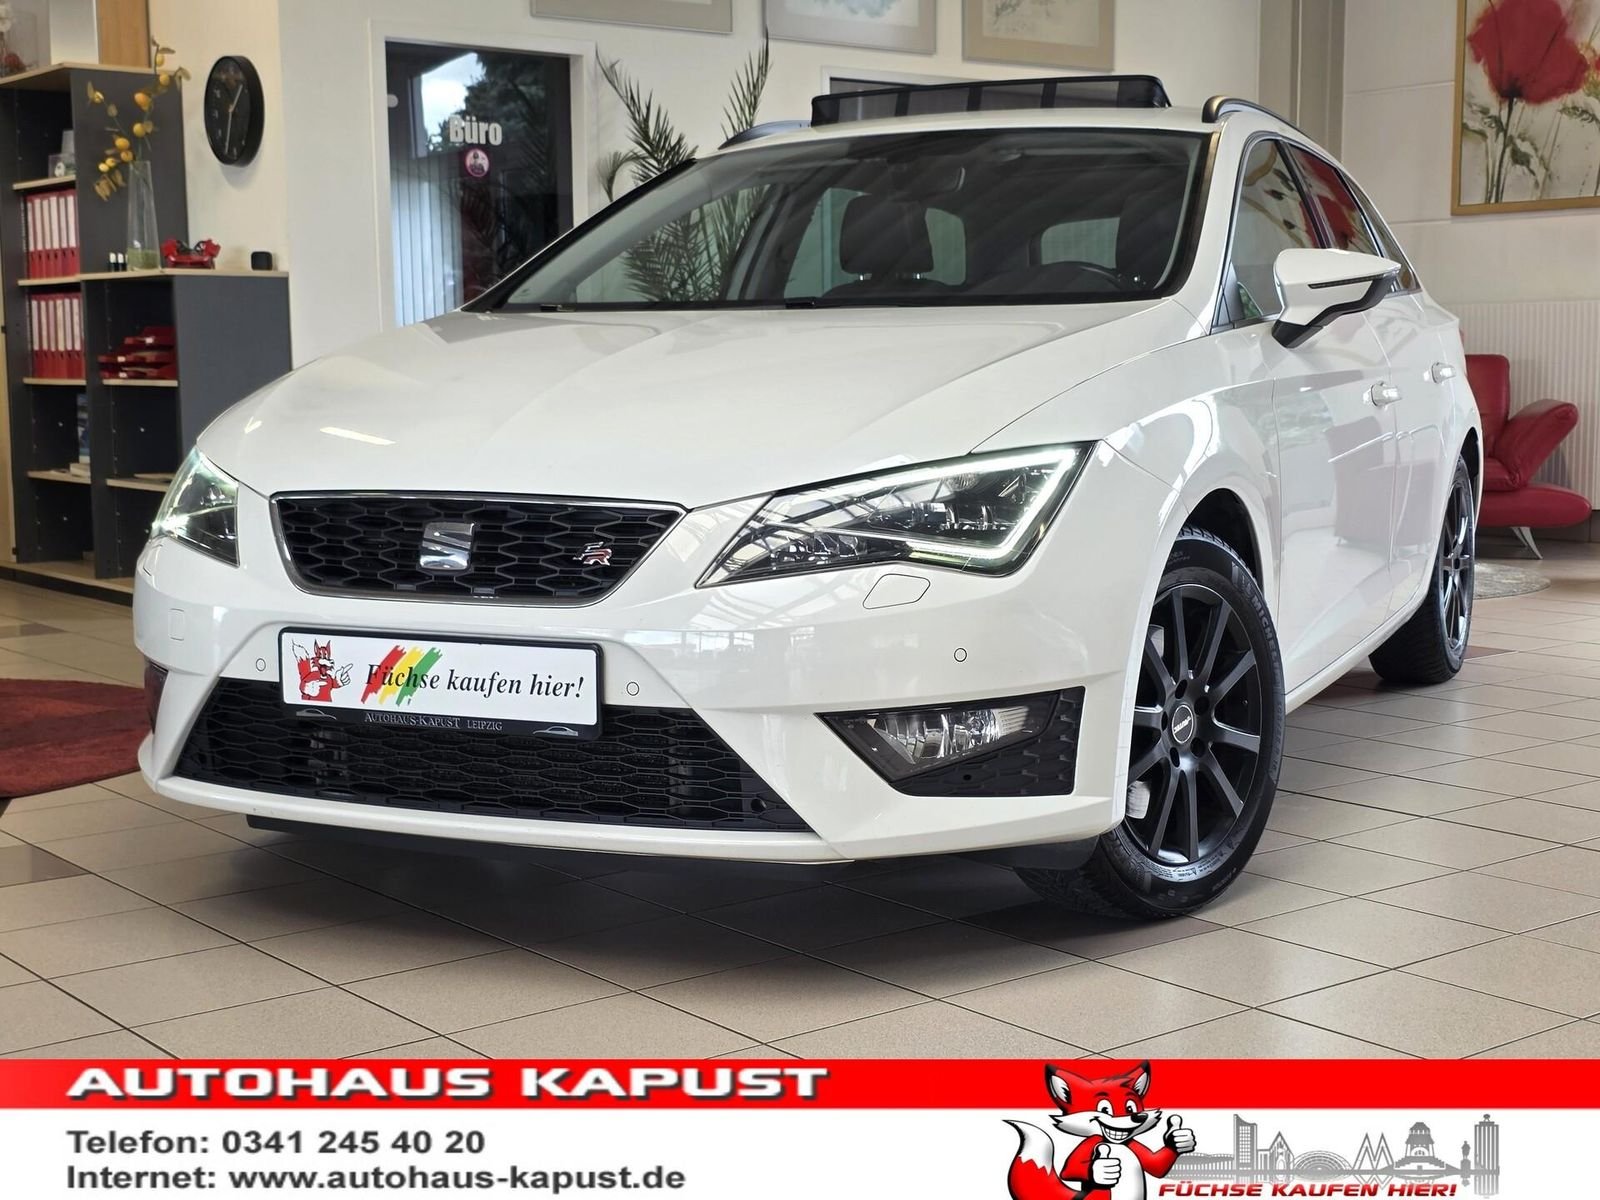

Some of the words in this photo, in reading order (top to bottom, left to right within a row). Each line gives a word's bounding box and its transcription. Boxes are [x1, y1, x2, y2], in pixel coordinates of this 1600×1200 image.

[448, 114, 503, 146] Büro
[365, 663, 441, 689] Füchse
[446, 668, 522, 699] kaufen
[529, 673, 585, 699] hier!
[364, 711, 461, 729] AUTOHAUS-KAPUST
[467, 718, 503, 732] LEIPZIG
